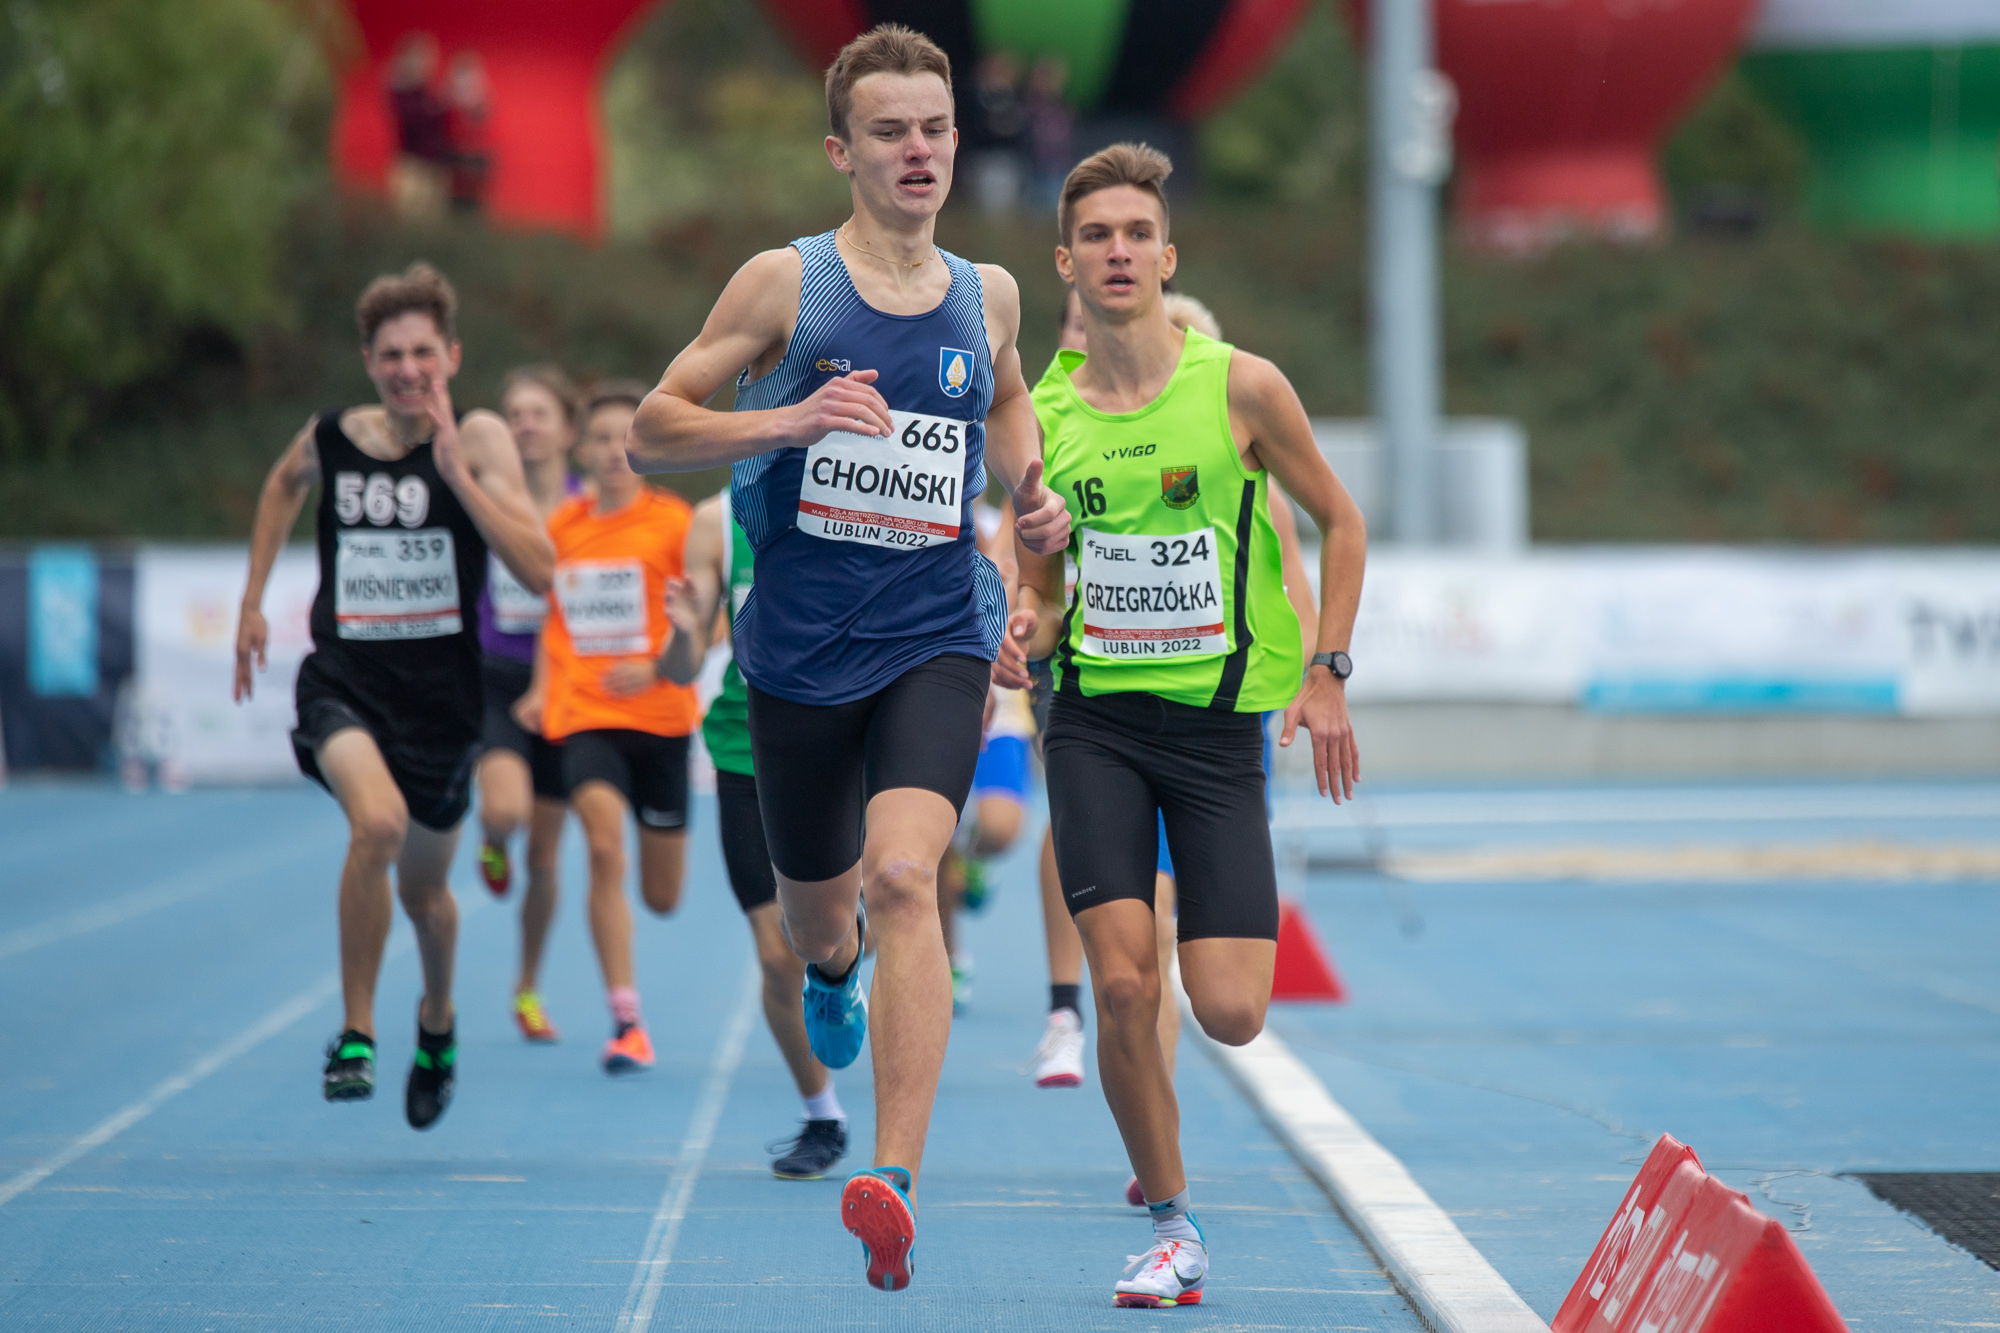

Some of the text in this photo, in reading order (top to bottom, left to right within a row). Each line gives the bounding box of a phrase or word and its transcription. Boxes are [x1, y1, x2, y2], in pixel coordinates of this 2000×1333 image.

[901, 419, 959, 454] 665
[811, 456, 956, 507] CHOIŃSKI
[1072, 477, 1107, 519] 16
[334, 470, 431, 529] 569
[397, 538, 446, 563] 359
[823, 520, 929, 548] LUBLIN 2022
[1150, 535, 1210, 567] 324
[1085, 580, 1218, 613] GRZEGRZÓŁKA
[1102, 638, 1202, 654] LUBLIN 2022
